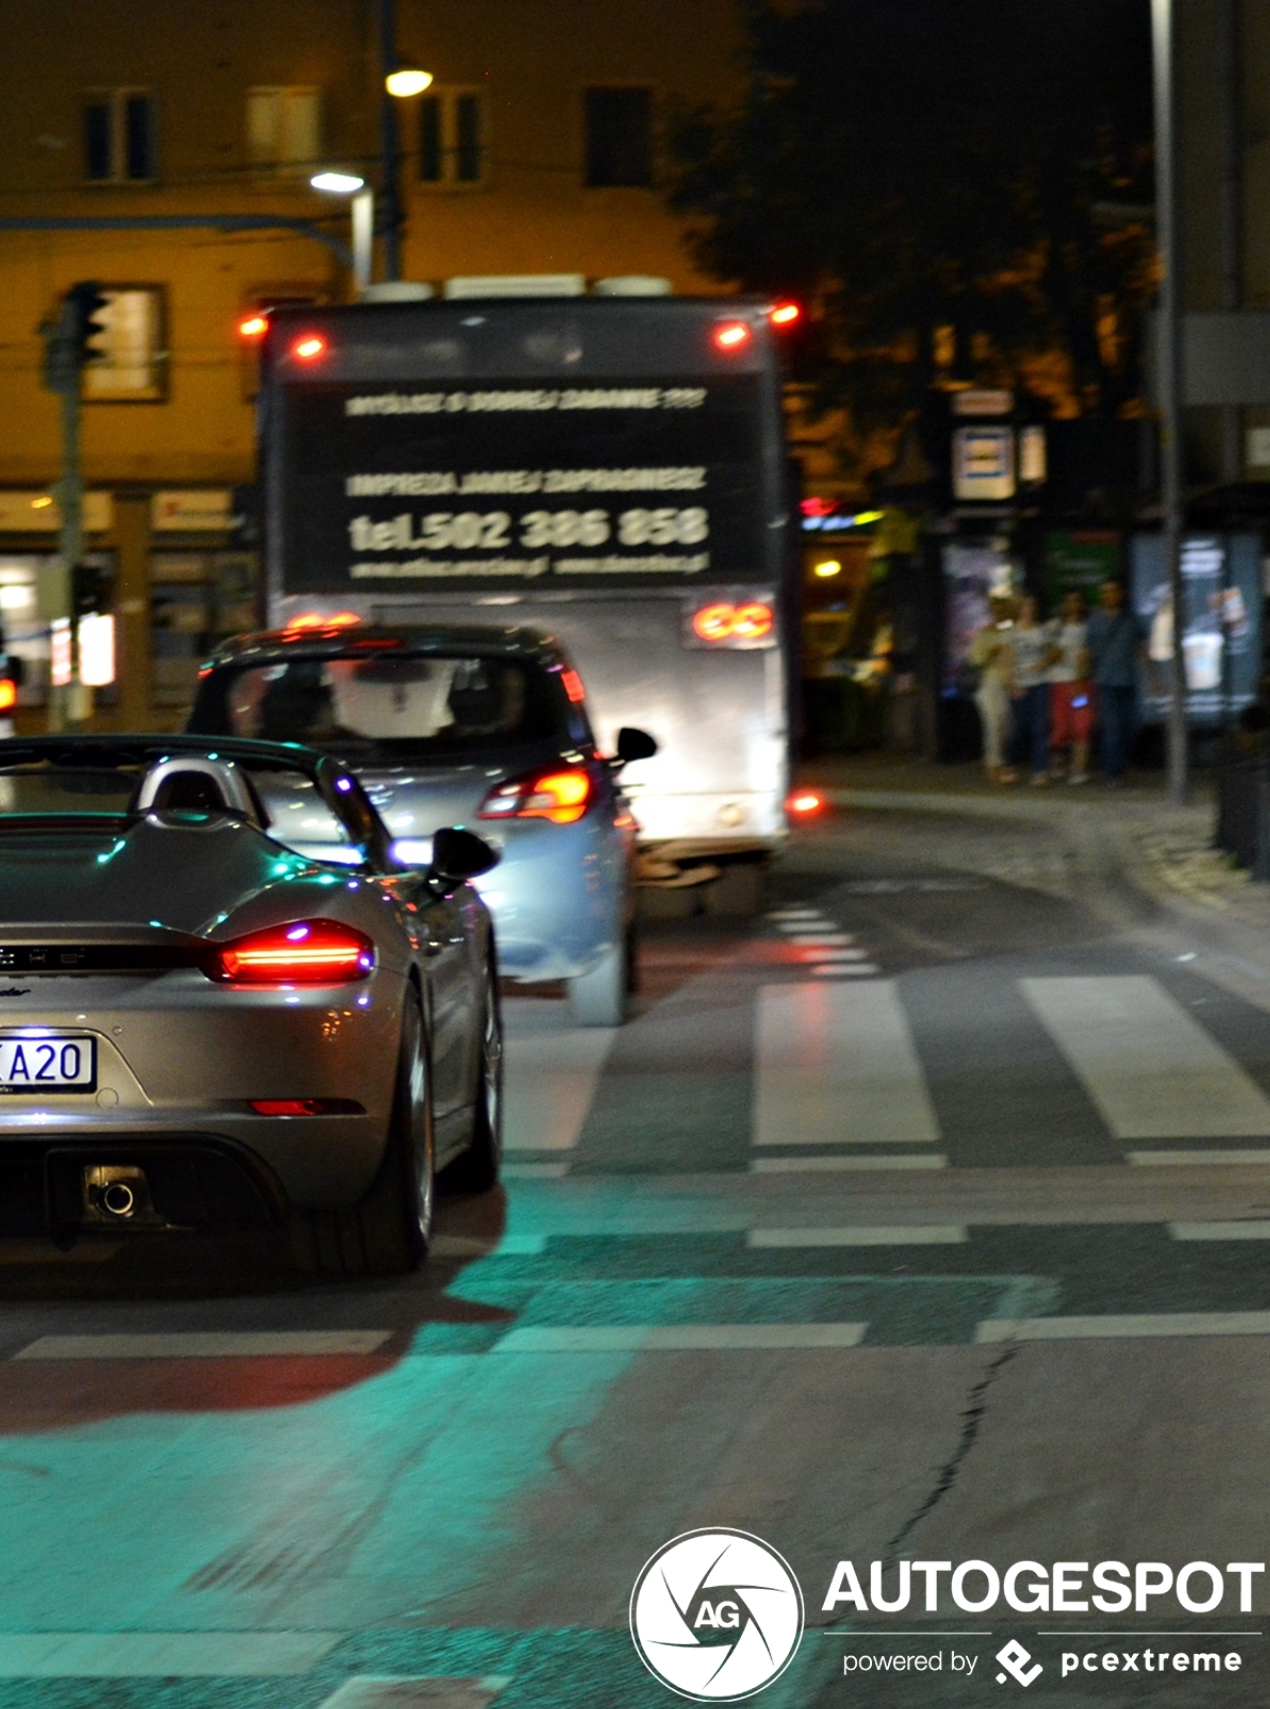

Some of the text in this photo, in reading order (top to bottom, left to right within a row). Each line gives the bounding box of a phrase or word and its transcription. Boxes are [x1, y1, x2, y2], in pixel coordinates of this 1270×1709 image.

[346, 472, 456, 497] IMPREZA
[348, 507, 709, 551] tel.502 386 858
